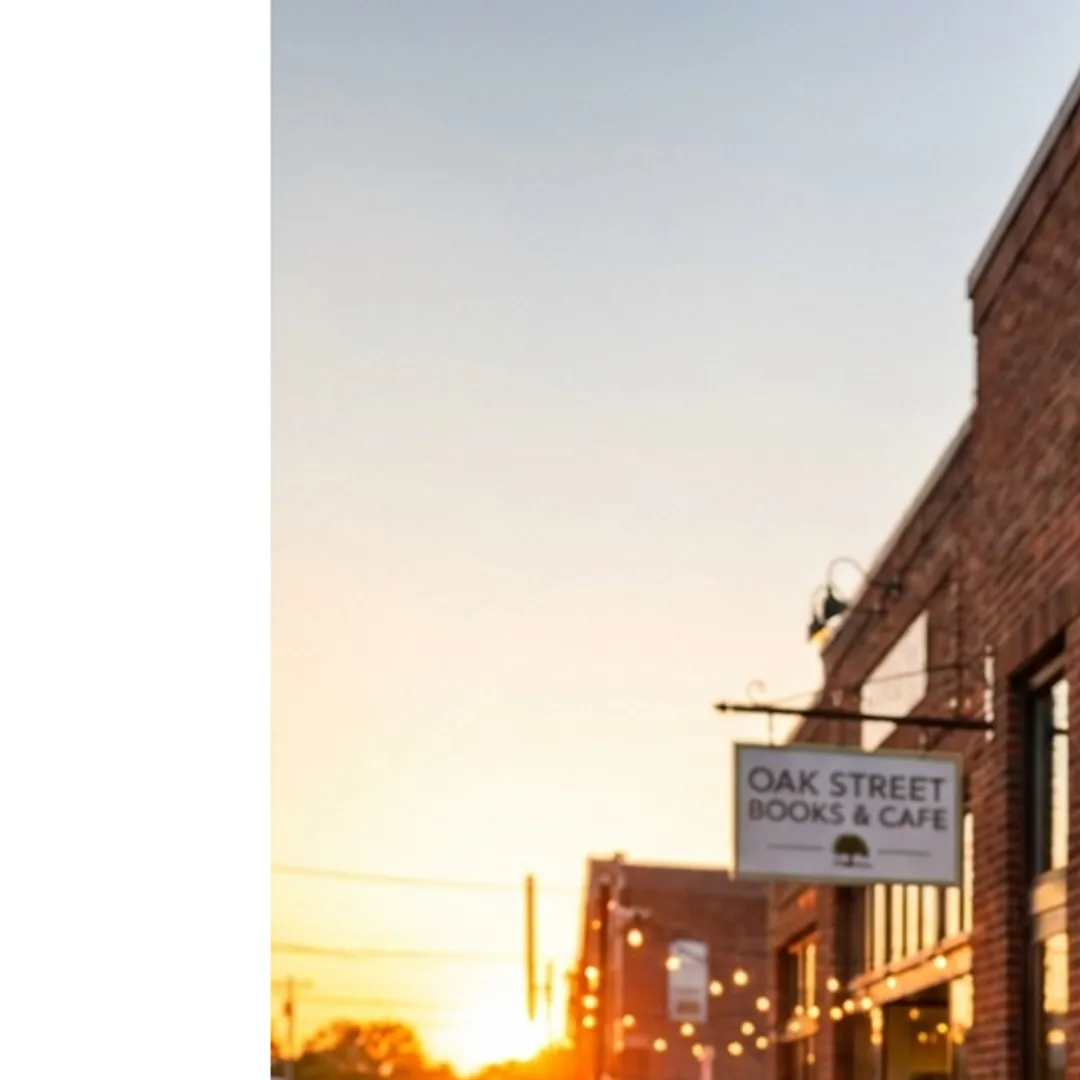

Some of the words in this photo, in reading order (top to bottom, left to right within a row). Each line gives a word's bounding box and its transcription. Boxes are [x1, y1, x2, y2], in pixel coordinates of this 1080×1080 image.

[748, 766, 820, 795] OAK
[830, 771, 947, 803] STREET
[748, 798, 844, 825] BOOKS
[853, 804, 870, 827] &
[879, 804, 948, 831] CAFE
